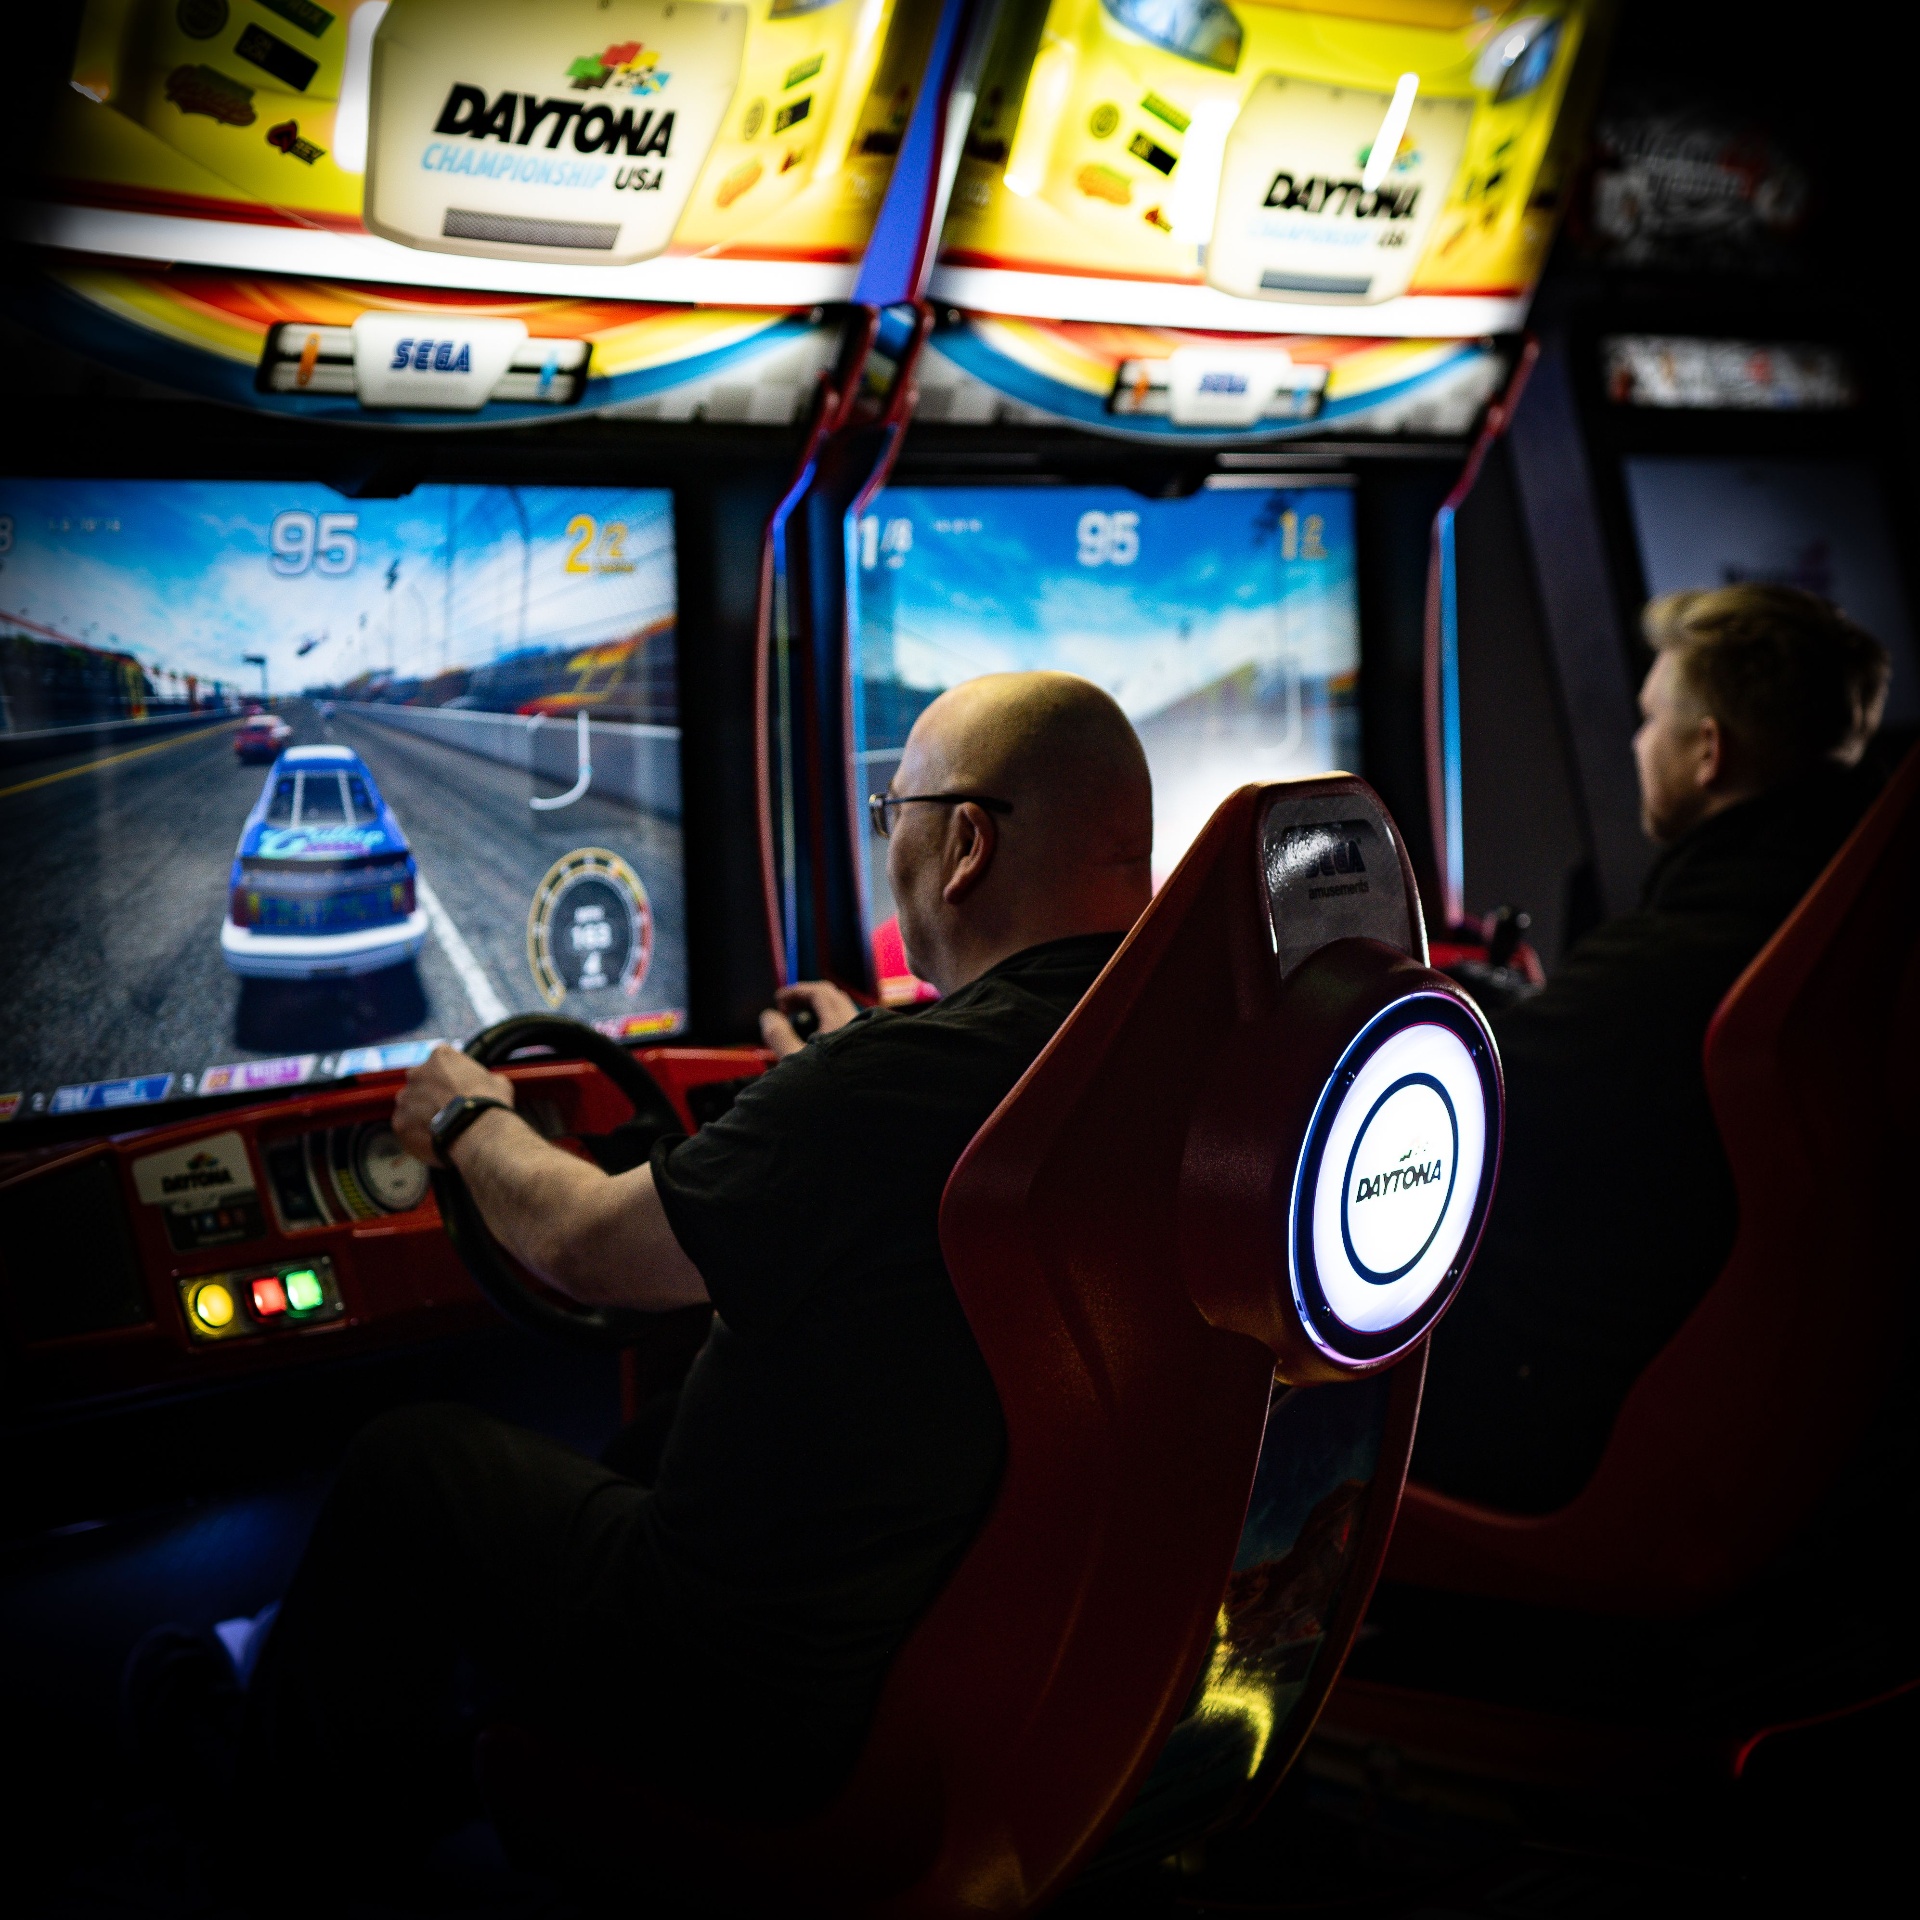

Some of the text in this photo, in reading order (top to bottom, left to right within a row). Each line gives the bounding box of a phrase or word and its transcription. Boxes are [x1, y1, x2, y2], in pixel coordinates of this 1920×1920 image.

[433, 82, 677, 157] DAYTONA
[421, 143, 664, 191] CHAMPIONSHIP USA
[1262, 172, 1421, 219] DAYTONA
[390, 338, 470, 371] SEGA
[272, 510, 359, 574] 95
[1076, 510, 1140, 566] 95
[1308, 881, 1370, 899] amusements
[1356, 1159, 1441, 1203] DAYTONA
